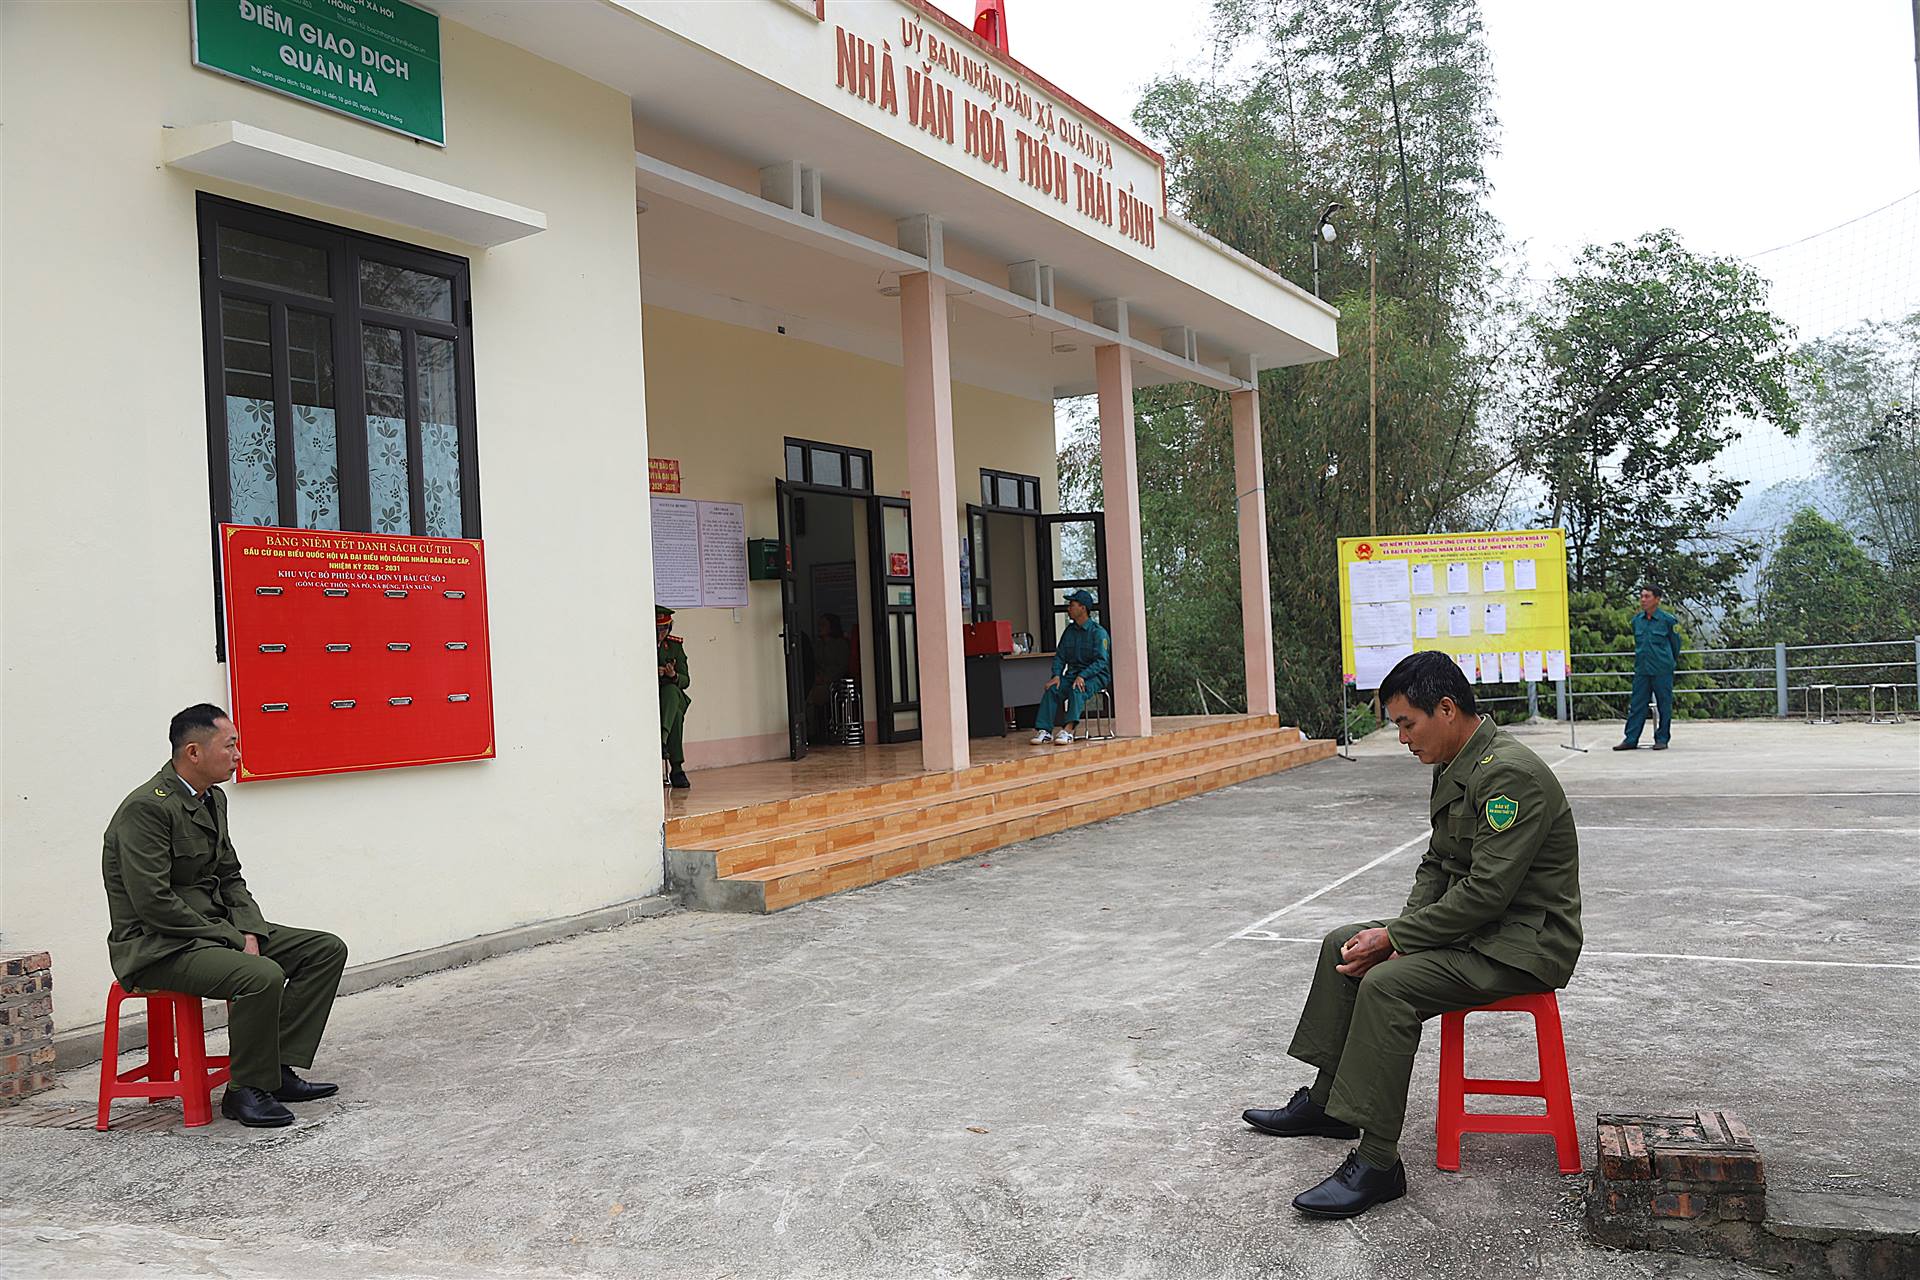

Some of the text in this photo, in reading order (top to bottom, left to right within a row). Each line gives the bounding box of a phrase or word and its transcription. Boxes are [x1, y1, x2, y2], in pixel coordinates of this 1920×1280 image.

[239, 0, 409, 80] ĐIỂM GIAO DỊCH
[279, 45, 378, 97] QUÂN HÀ
[928, 34, 960, 77] BAN
[962, 62, 1001, 102] NHÂN
[1004, 82, 1032, 120] DÂN
[1035, 101, 1055, 135] XÃ
[1059, 117, 1094, 159] QUÂN
[1097, 141, 1113, 169] HÀ
[836, 25, 898, 116] NHÀ
[906, 61, 954, 145] VĂN
[1015, 129, 1067, 205] THÔN
[1073, 162, 1113, 227] THÁI
[1118, 181, 1155, 250] BÌNH
[243, 546, 259, 556] BẦU
[261, 547, 272, 556] CỬ
[273, 549, 286, 559] ĐẠI
[287, 548, 304, 558] BIỂU
[305, 549, 325, 559] QUỐC
[326, 551, 338, 560] HỘI
[340, 552, 349, 560] VÀ
[350, 553, 361, 562] ĐẠI
[363, 552, 378, 561] BIỂU
[380, 554, 391, 562] HỘI
[392, 554, 410, 563] ĐỒNG
[266, 533, 451, 554] BẢNG NIÊM YẾT DANH SÁCH CỬ TRI
[278, 570, 297, 578] KHU
[298, 570, 317, 580] VỰC
[318, 570, 330, 579] BỎ
[331, 571, 355, 580] PHIẾU
[357, 571, 367, 580] SỐ
[376, 573, 392, 581] ĐƠN
[403, 574, 418, 582] BẦU
[431, 574, 440, 582] SỐ
[329, 562, 351, 571] NHIỆM
[363, 563, 379, 571] 2026
